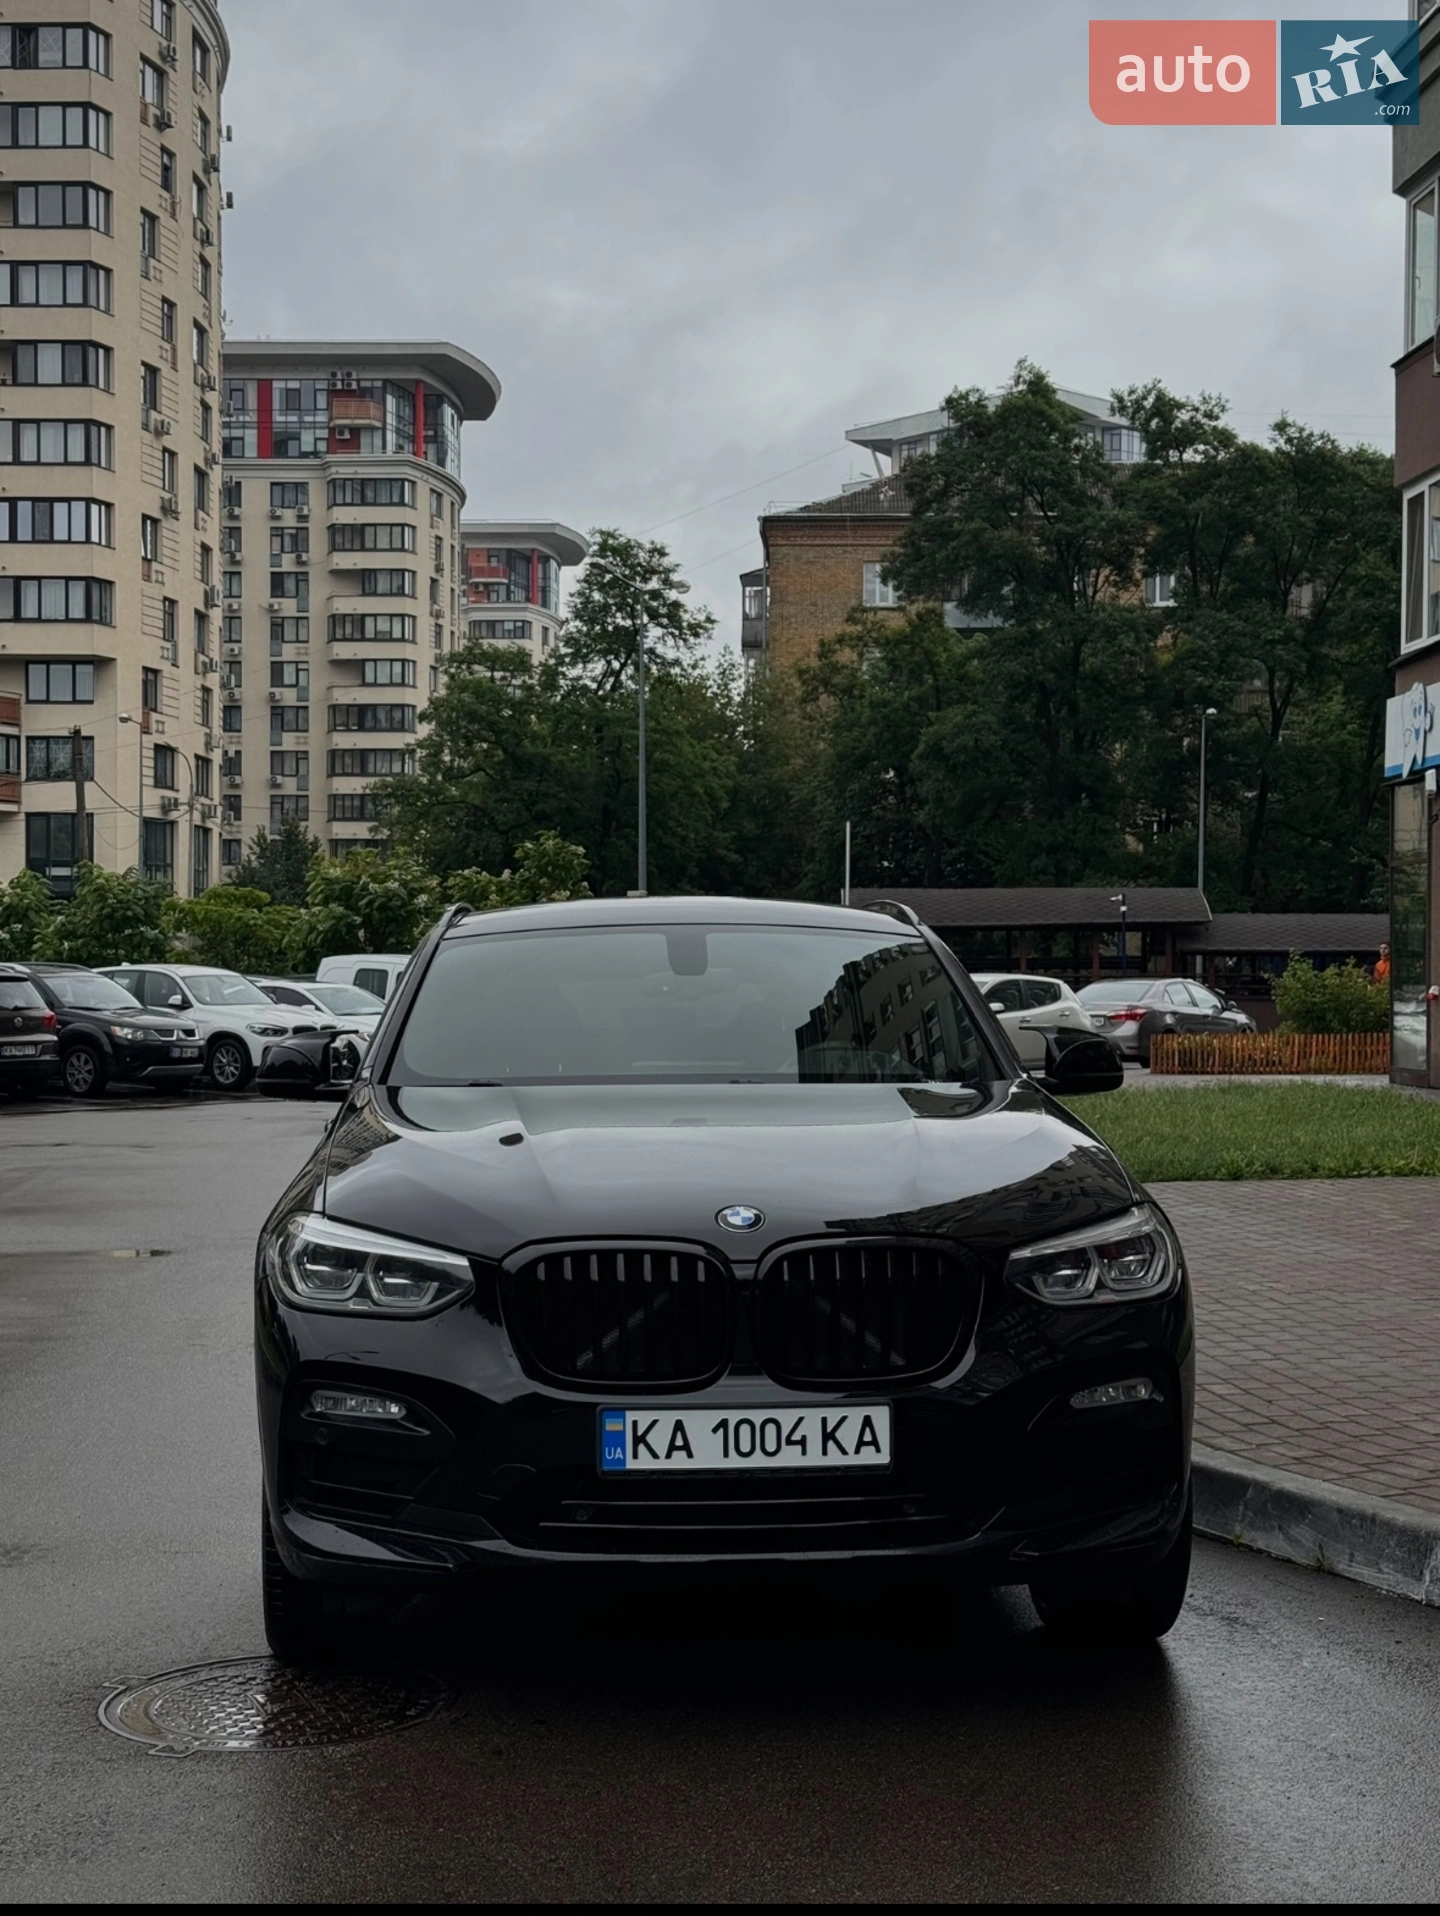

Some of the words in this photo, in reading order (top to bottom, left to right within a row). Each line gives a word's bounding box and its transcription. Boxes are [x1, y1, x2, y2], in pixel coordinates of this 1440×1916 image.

[631, 1418, 694, 1460] KA
[711, 1416, 807, 1459] 1004
[821, 1414, 881, 1456] KA
[605, 1447, 623, 1459] UA
